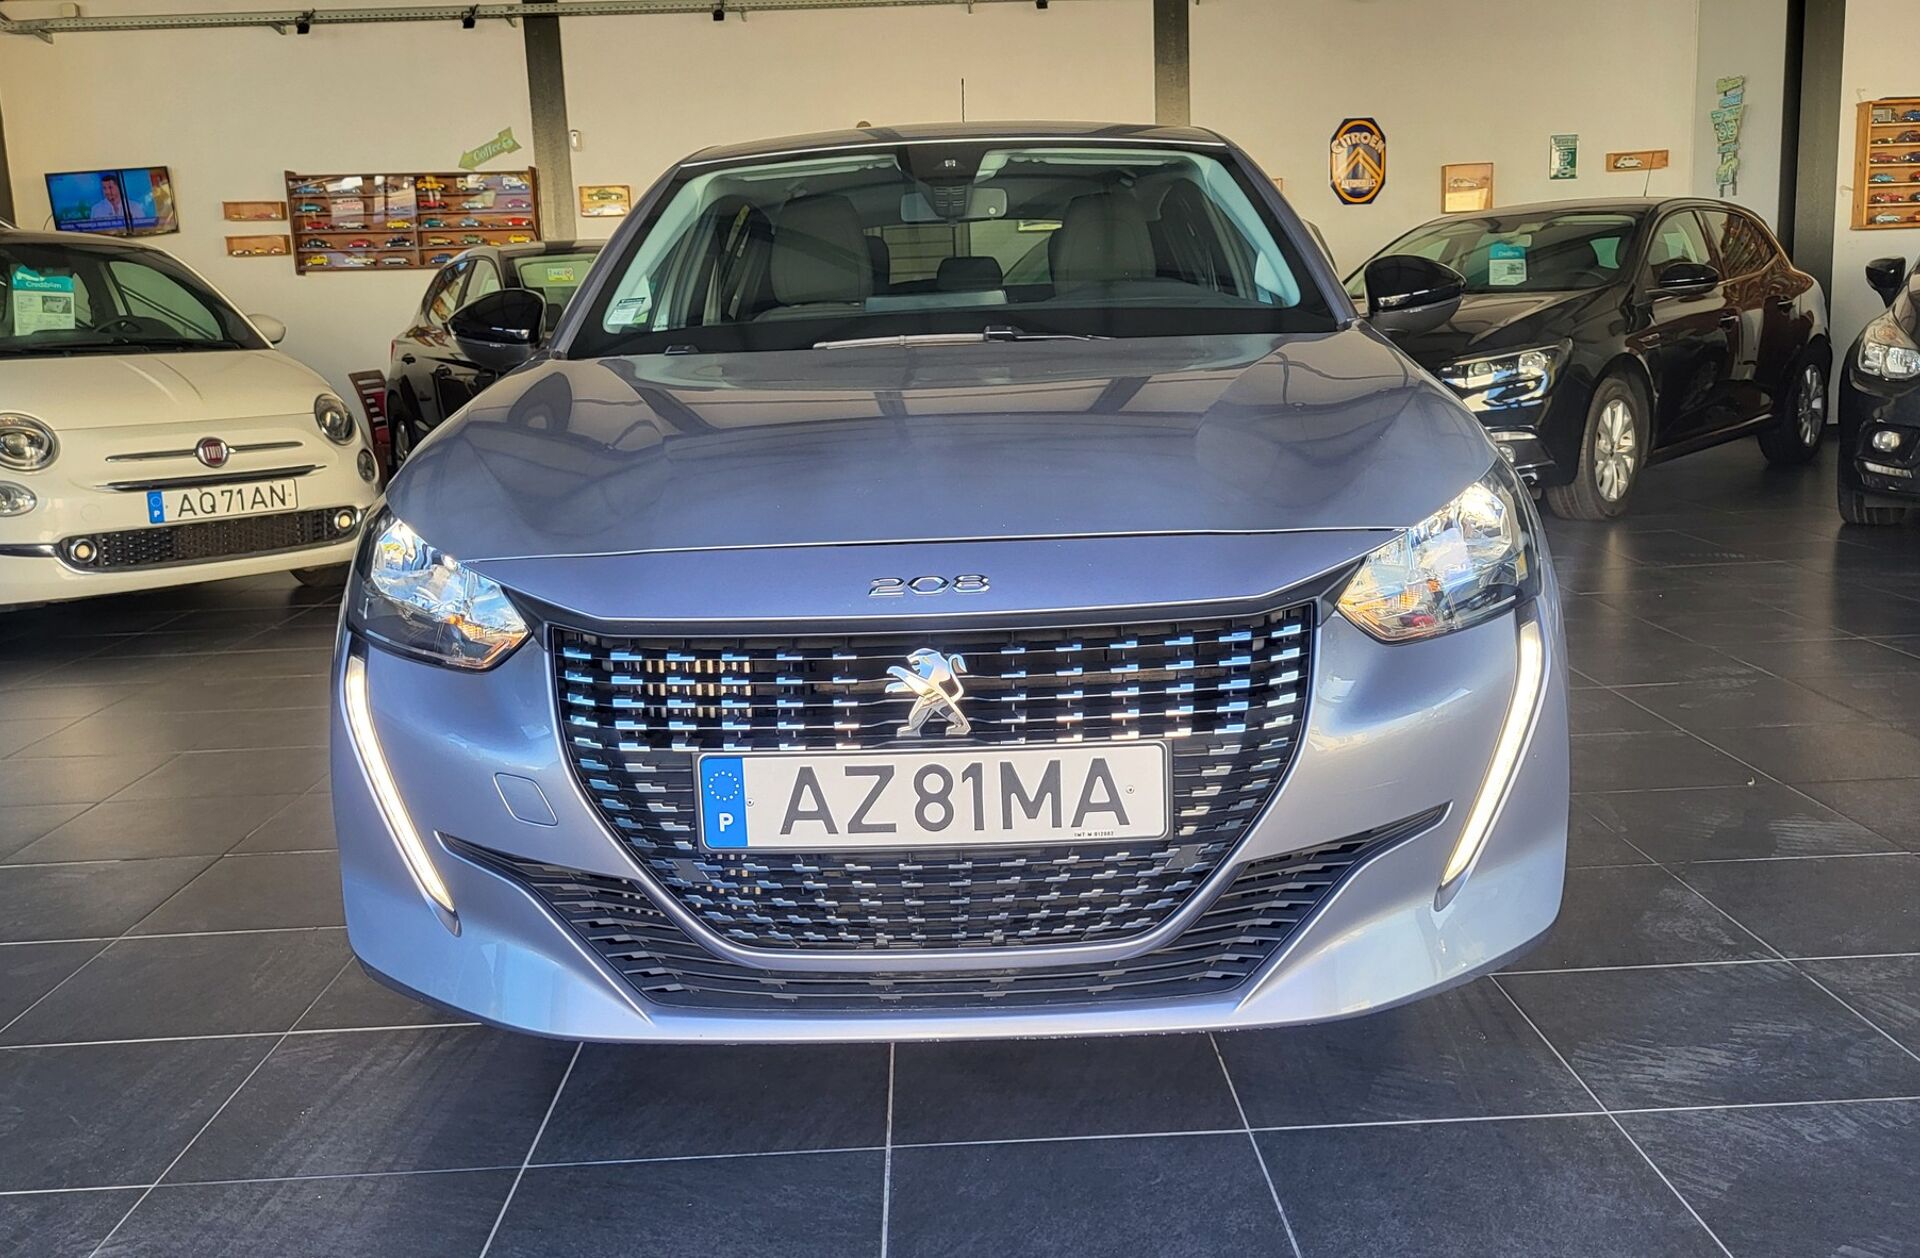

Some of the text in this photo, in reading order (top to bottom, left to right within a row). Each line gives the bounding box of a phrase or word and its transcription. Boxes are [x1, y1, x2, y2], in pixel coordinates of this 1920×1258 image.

[154, 510, 161, 518] P
[869, 574, 990, 597] 208
[719, 812, 734, 832] P
